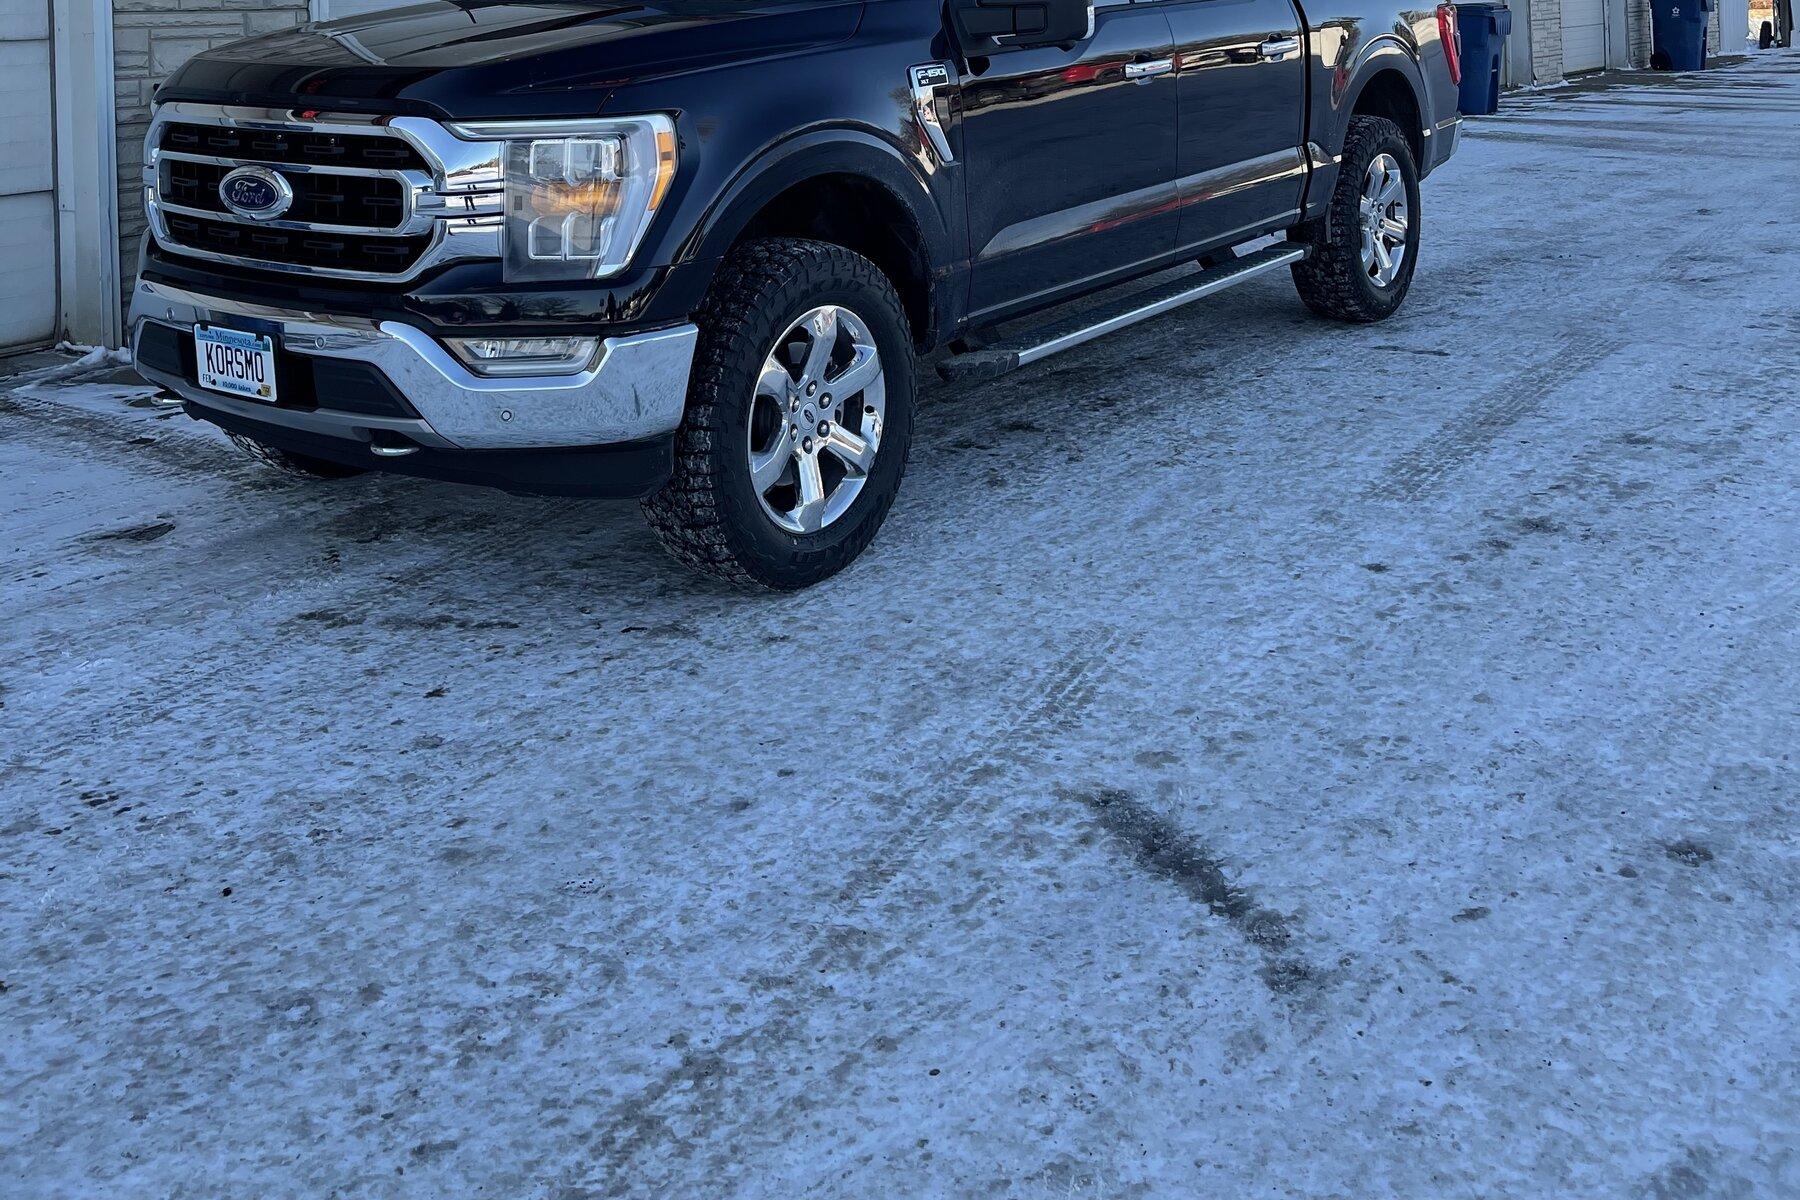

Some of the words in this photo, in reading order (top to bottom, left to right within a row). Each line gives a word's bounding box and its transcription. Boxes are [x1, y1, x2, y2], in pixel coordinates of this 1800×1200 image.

[917, 67, 947, 79] F-150
[231, 180, 266, 205] Ford
[215, 330, 253, 347] Minnesota
[205, 342, 265, 383] KORSMO
